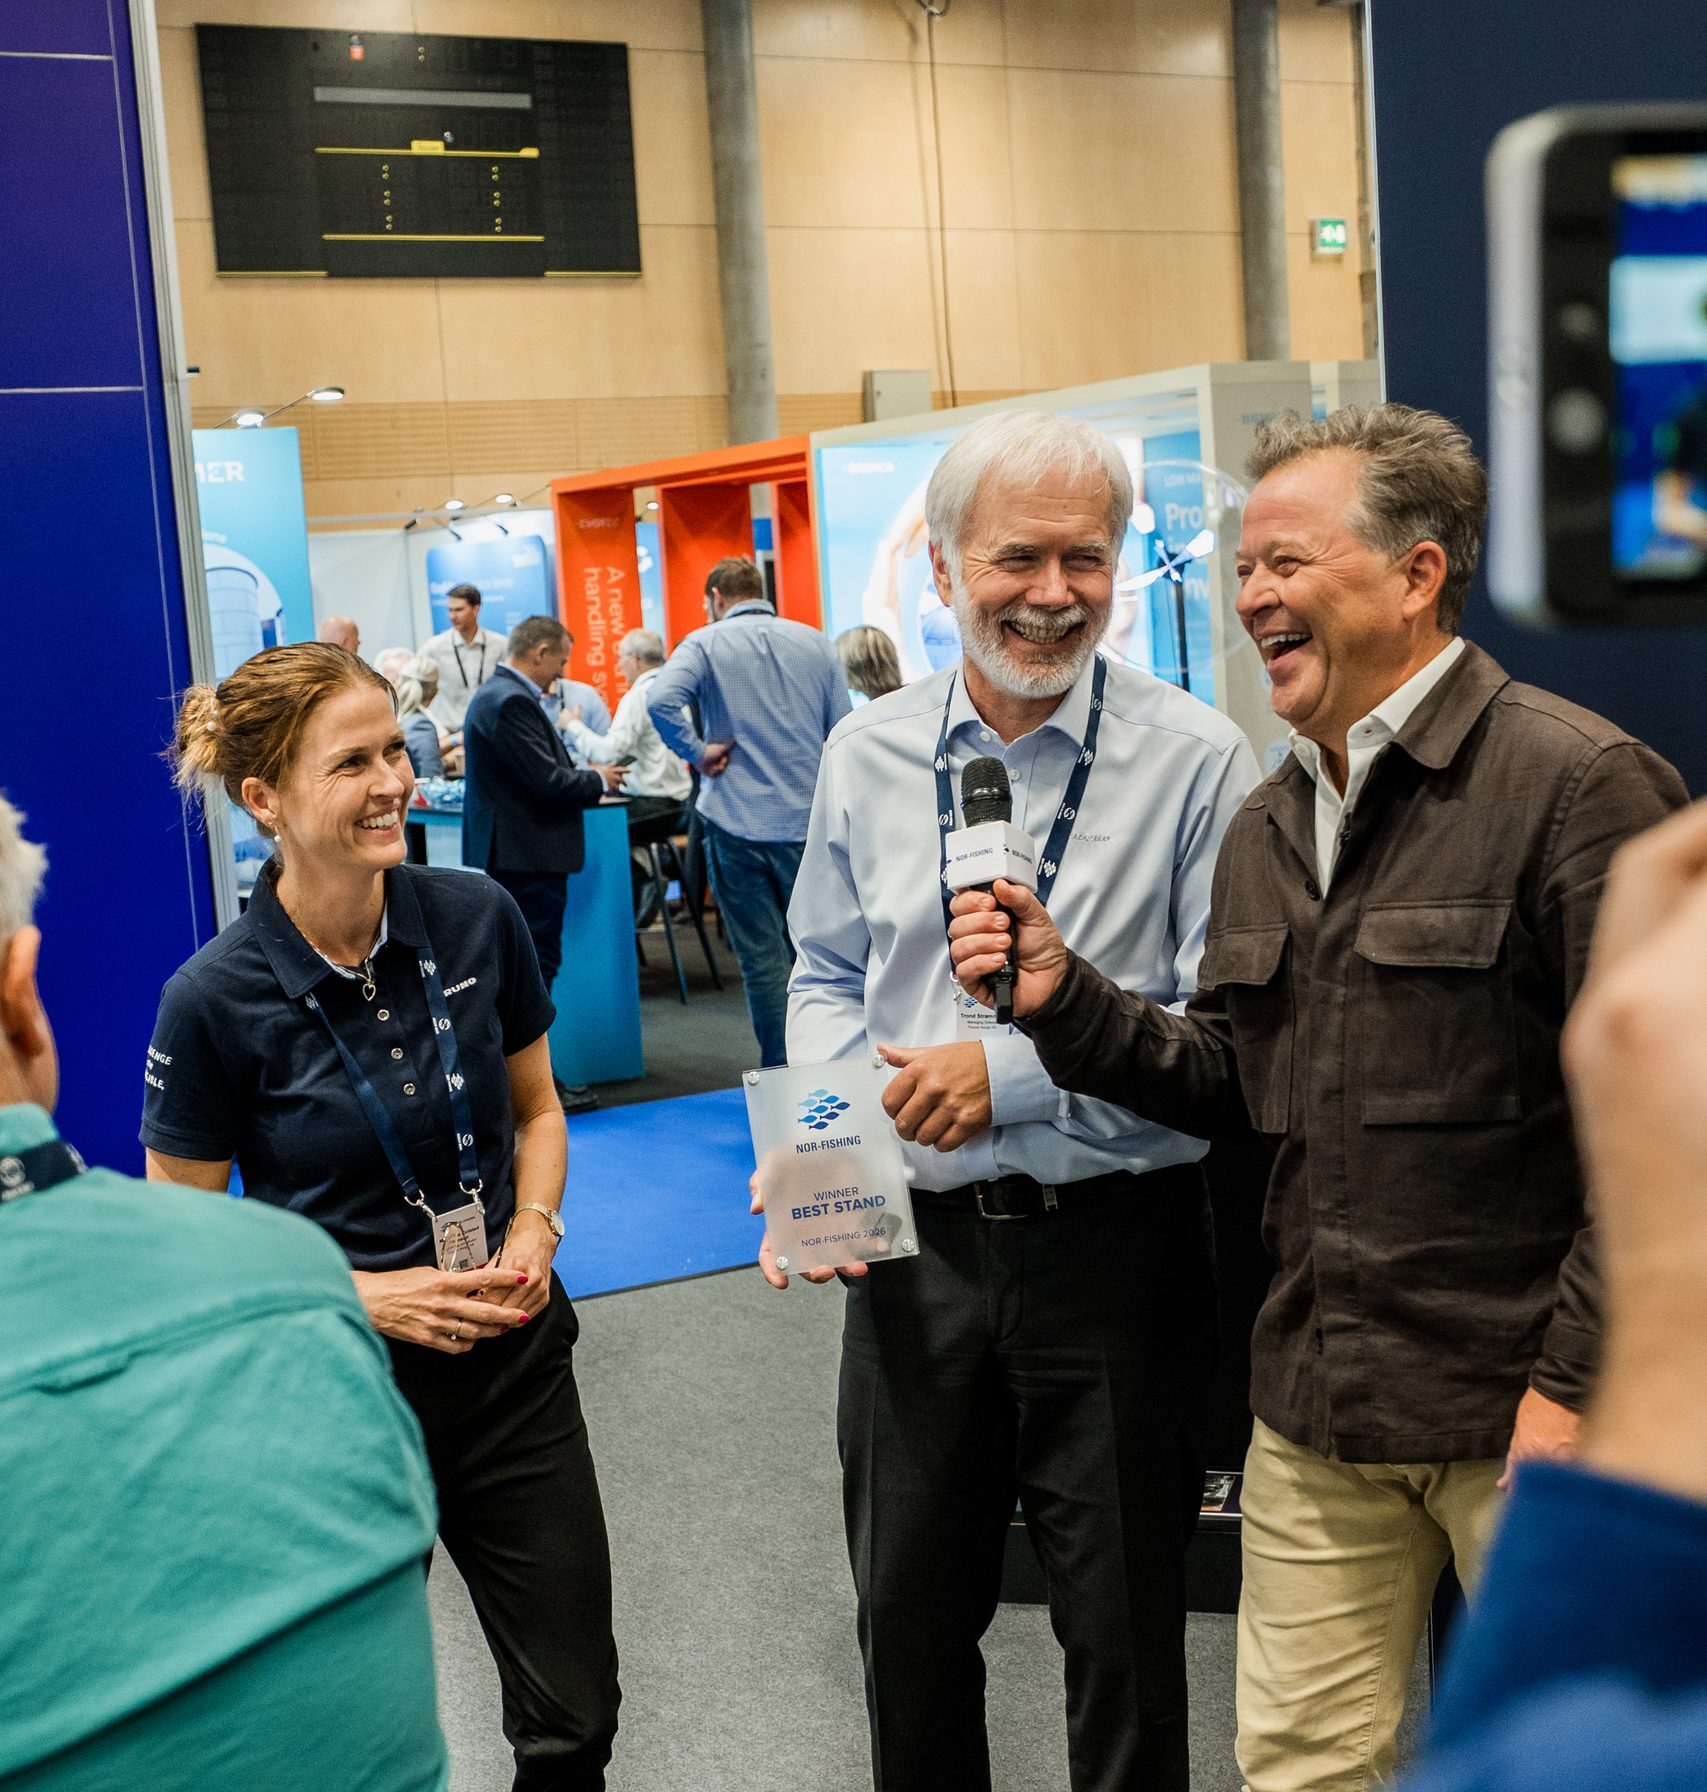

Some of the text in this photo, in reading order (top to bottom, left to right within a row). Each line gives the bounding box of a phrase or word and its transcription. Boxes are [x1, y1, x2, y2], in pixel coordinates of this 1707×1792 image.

[605, 566, 625, 585] A
[584, 567, 607, 666] handling
[608, 588, 625, 635] new
[956, 848, 993, 862] NOR-FISHING
[443, 977, 477, 997] RUNO
[796, 1135, 861, 1154] NOR-FISHING
[814, 1186, 859, 1201] WINNER
[791, 1195, 886, 1220] BEST STAND
[801, 1227, 886, 1247] NOR-FISHING 2026
